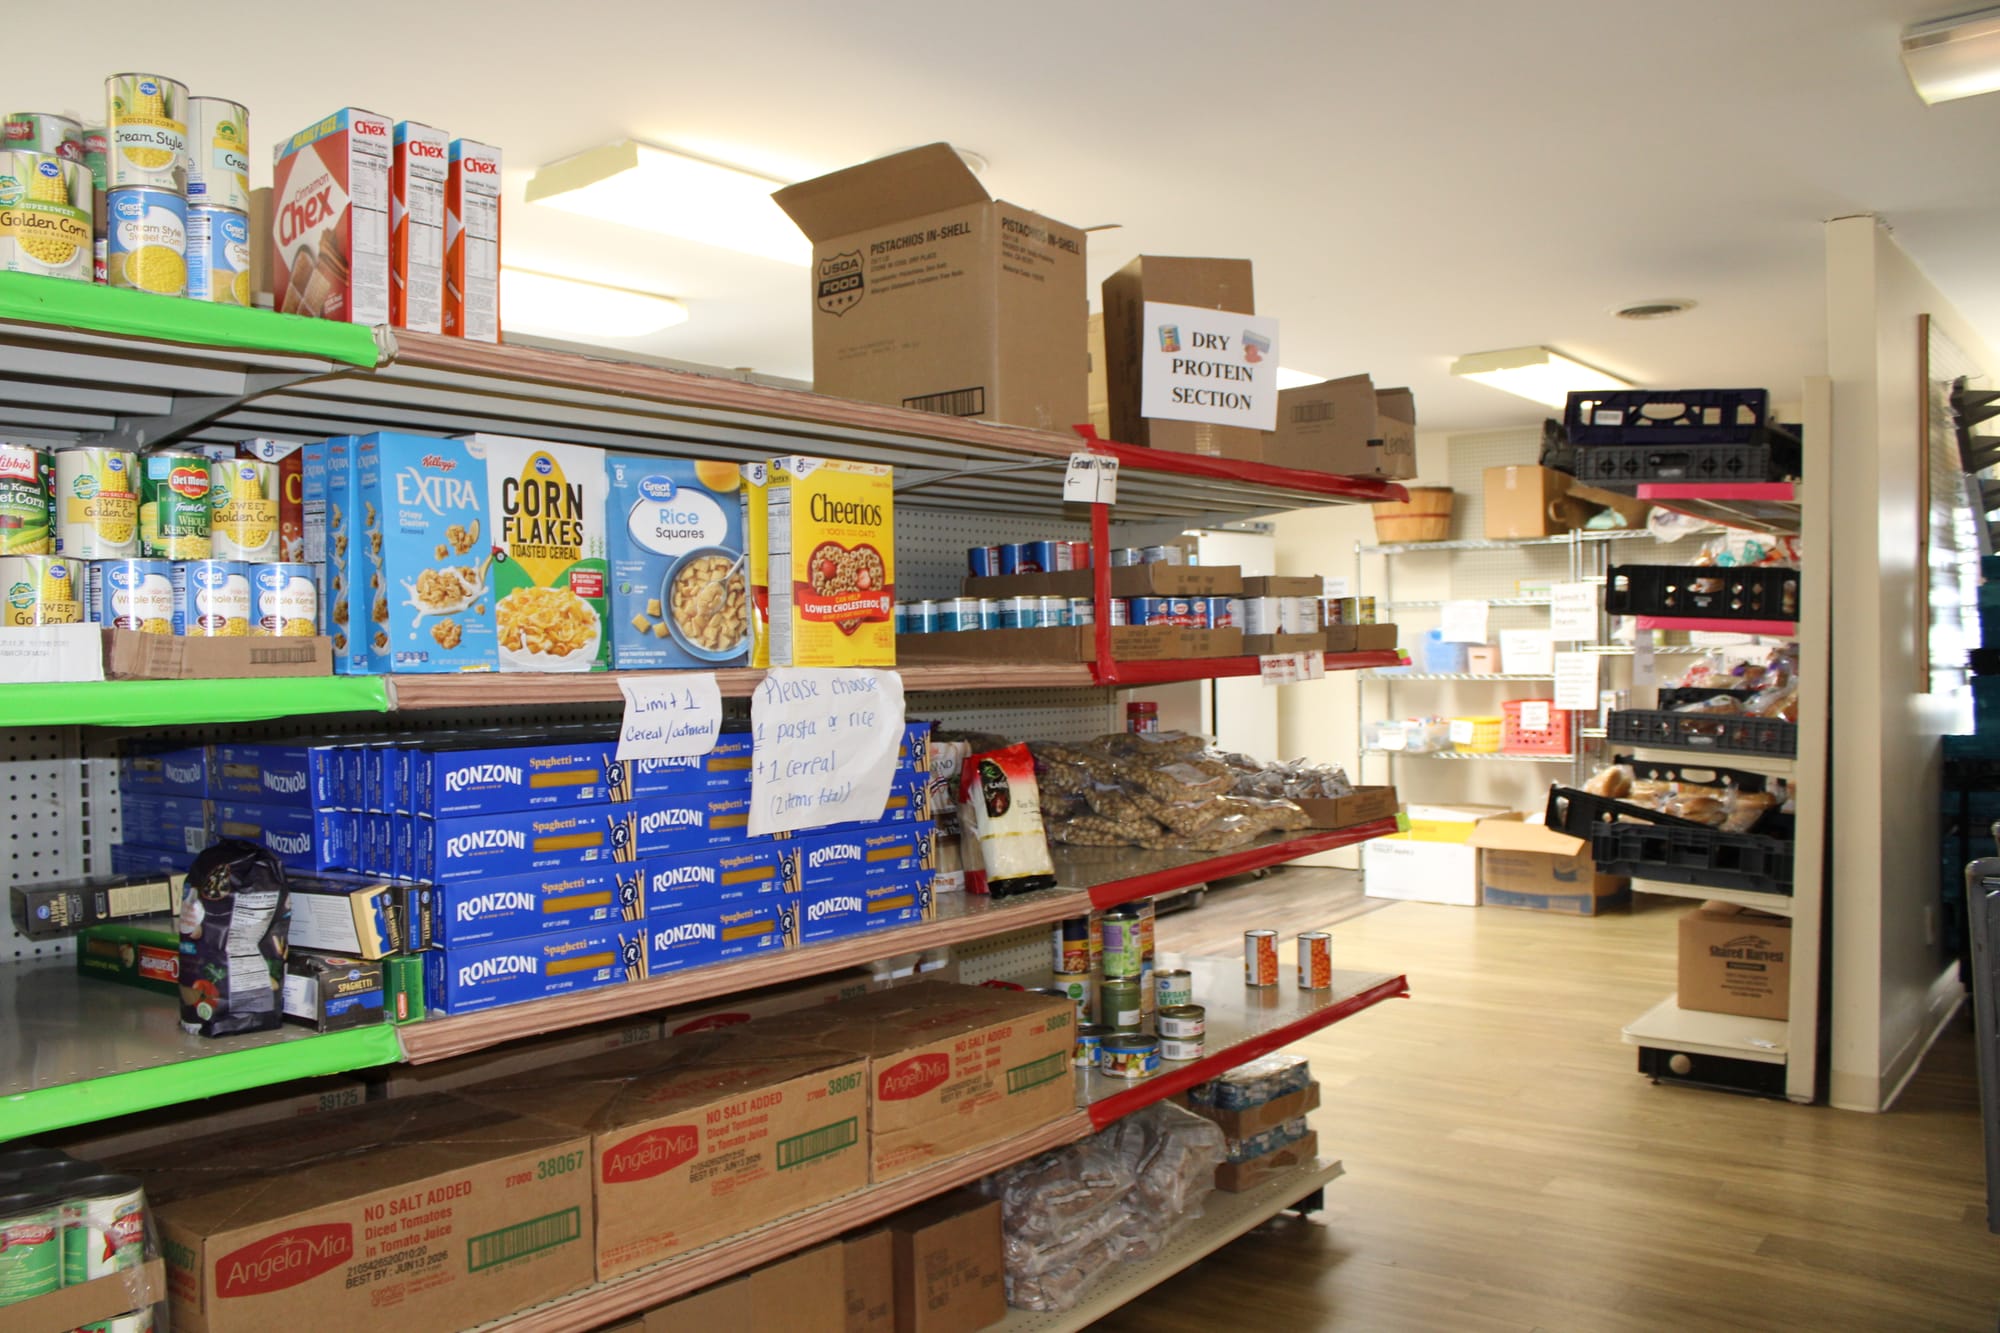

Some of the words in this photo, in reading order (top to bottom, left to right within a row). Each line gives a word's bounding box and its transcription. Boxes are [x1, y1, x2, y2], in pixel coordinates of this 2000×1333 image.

[354, 120, 386, 136] Chex
[156, 132, 184, 151] Style
[408, 140, 444, 159] Chex
[464, 157, 496, 174] Chex
[0, 212, 56, 230] Golden
[60, 218, 88, 240] Corn
[280, 185, 334, 246] Chex
[125, 223, 160, 232] Cream
[162, 226, 182, 238] Style
[128, 232, 159, 242] Sweet
[870, 232, 924, 256] PISTACHIOS
[926, 222, 972, 242] IN-SHELL
[822, 258, 859, 276] USDA
[822, 277, 860, 294] FOOD
[1192, 331, 1230, 352] DRY
[1172, 358, 1254, 382] PROTEIN
[1172, 386, 1252, 410] SECTION
[421, 454, 456, 472] Kellogg's
[172, 476, 190, 486] Del
[616, 468, 624, 482] 8
[10, 482, 41, 494] Kernel
[395, 466, 480, 516] EXTRA
[642, 481, 670, 492] Great
[650, 490, 671, 499] Value
[16, 492, 45, 509] Corn
[175, 502, 192, 512] Fresh
[230, 502, 267, 511] SWEET
[502, 476, 584, 520] CORN
[810, 492, 882, 526] Cheerios
[178, 514, 206, 527] WHOLE
[214, 510, 254, 524] Golden
[658, 508, 700, 525] Rice
[164, 524, 196, 536] KERNEL
[502, 516, 584, 546] FLAKES
[655, 526, 705, 542] Squares
[512, 544, 546, 560] TOASTED
[550, 545, 578, 560] CEREAL
[804, 603, 832, 614] LOWER
[832, 599, 880, 612] CHOLESTEROL
[628, 687, 676, 712] Limit
[683, 688, 702, 711] 1
[764, 675, 818, 704] Please
[831, 675, 878, 696] choose
[776, 718, 817, 743] pasta
[828, 714, 838, 729] or
[849, 712, 874, 728] rice
[529, 754, 572, 770] Spaghetti
[638, 756, 701, 775] RONZONI
[786, 750, 836, 778] cereal
[263, 770, 306, 793] RONZONI
[444, 764, 524, 792] RONZONI
[708, 798, 743, 812] Spaghetti
[532, 818, 576, 833] Spaghetti
[640, 808, 703, 834] RONZONI
[265, 830, 310, 854] RONZONI
[446, 828, 526, 858] RONZONI
[719, 855, 754, 868] Spaghetti
[808, 844, 862, 868] RONZONI
[542, 878, 586, 894] Spaghetti
[652, 866, 716, 892] RONZONI
[456, 892, 536, 922] RONZONI
[718, 909, 754, 923] Spaghetti
[808, 896, 862, 921] RONZONI
[544, 939, 588, 956] Spaghetti
[654, 922, 716, 952] RONZONI
[458, 955, 538, 988] RONZONI
[338, 978, 373, 994] SPAGHETTI
[922, 1060, 946, 1082] Mia
[828, 1072, 862, 1096] 38067
[320, 1088, 358, 1112] 39125
[706, 1110, 721, 1124] NO
[724, 1102, 748, 1120] SALT
[750, 1092, 782, 1112] ADDED
[608, 1142, 664, 1178] Angela
[665, 1136, 694, 1159] Mia
[505, 1170, 532, 1188] 27000
[537, 1151, 584, 1180] 38067
[364, 1204, 385, 1222] NO
[390, 1193, 422, 1216] SALT
[426, 1180, 472, 1206] ADDED
[364, 1222, 398, 1240] Diced
[400, 1207, 453, 1230] Tomatoes
[366, 1246, 376, 1258] in
[380, 1232, 421, 1254] Tomato
[423, 1224, 452, 1242] Juice
[225, 1245, 302, 1289] Angela
[306, 1234, 348, 1264] Mia
[346, 1272, 372, 1291] BEST
[374, 1267, 388, 1281] BY
